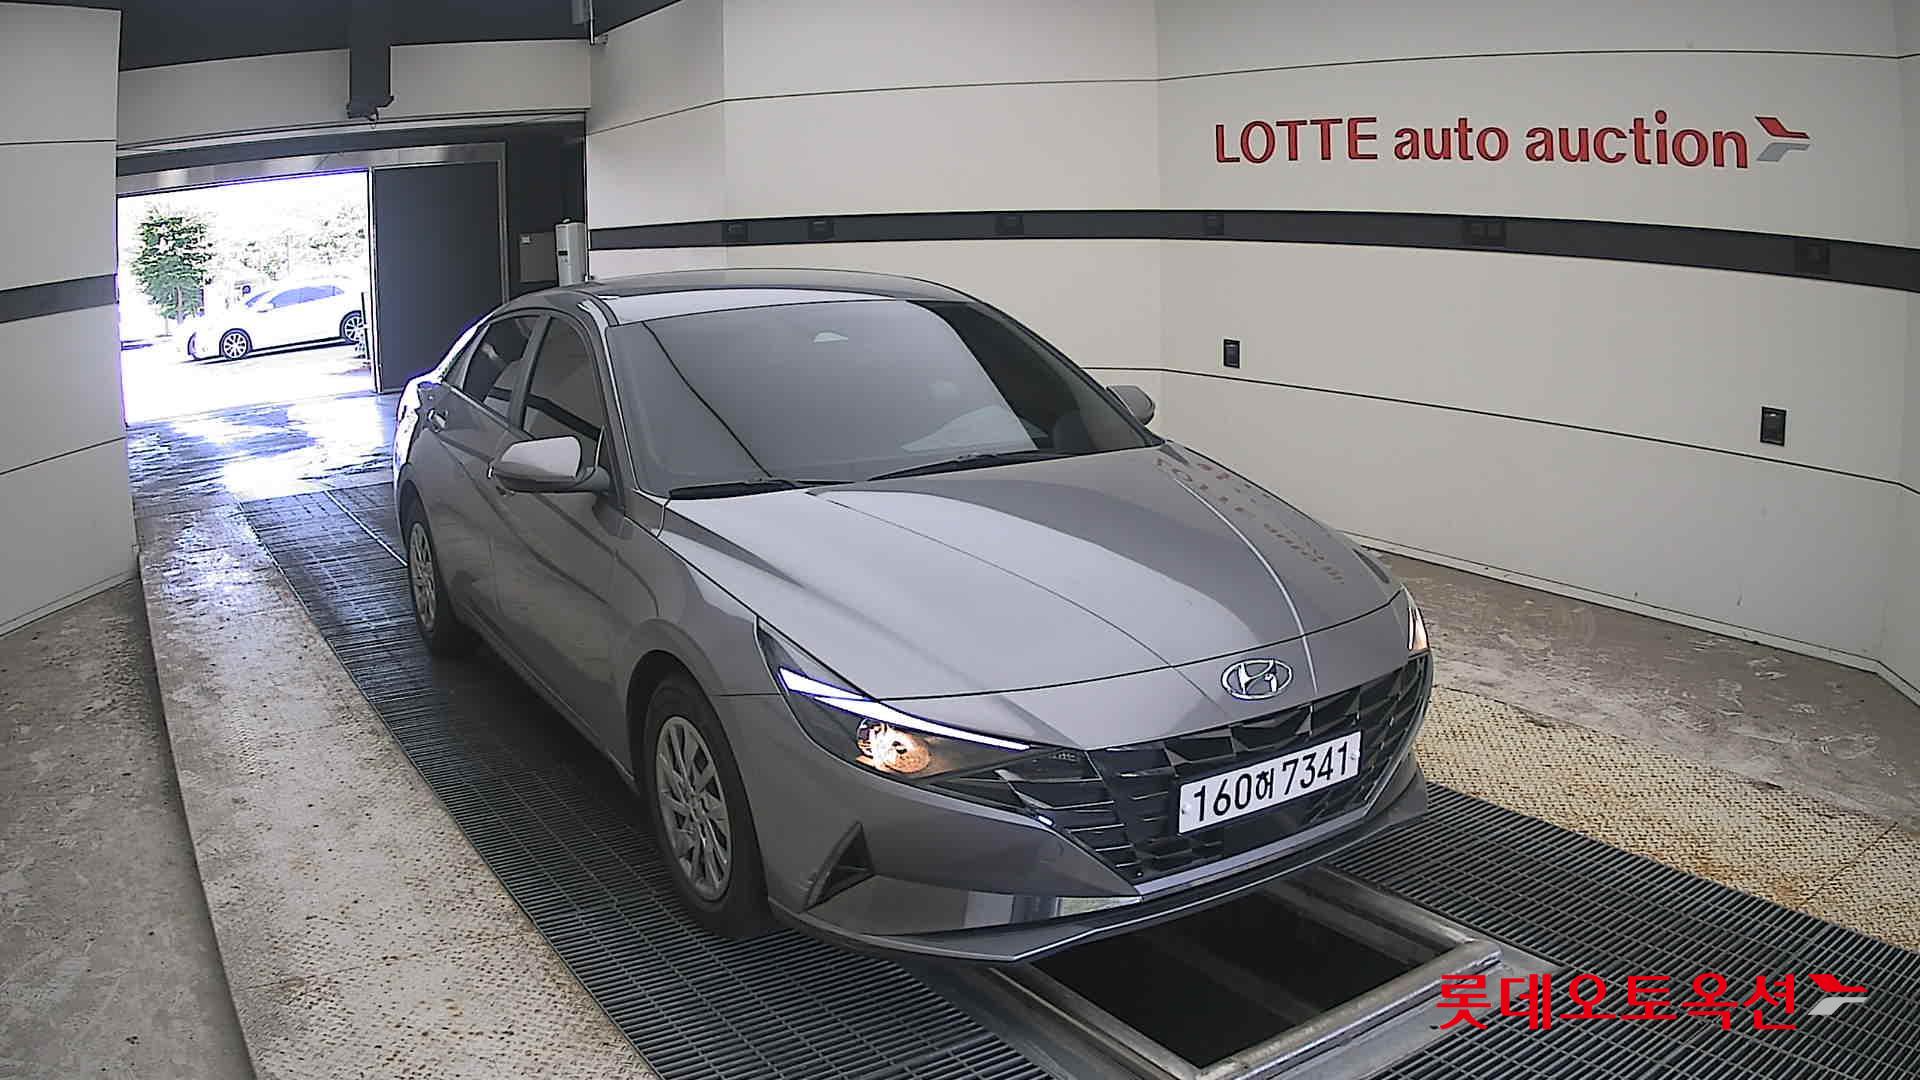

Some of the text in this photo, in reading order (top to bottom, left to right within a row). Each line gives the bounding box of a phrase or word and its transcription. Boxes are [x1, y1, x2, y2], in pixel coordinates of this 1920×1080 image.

[1215, 109, 1749, 169] LOTTE auto auction
[1281, 741, 1349, 796] 7341
